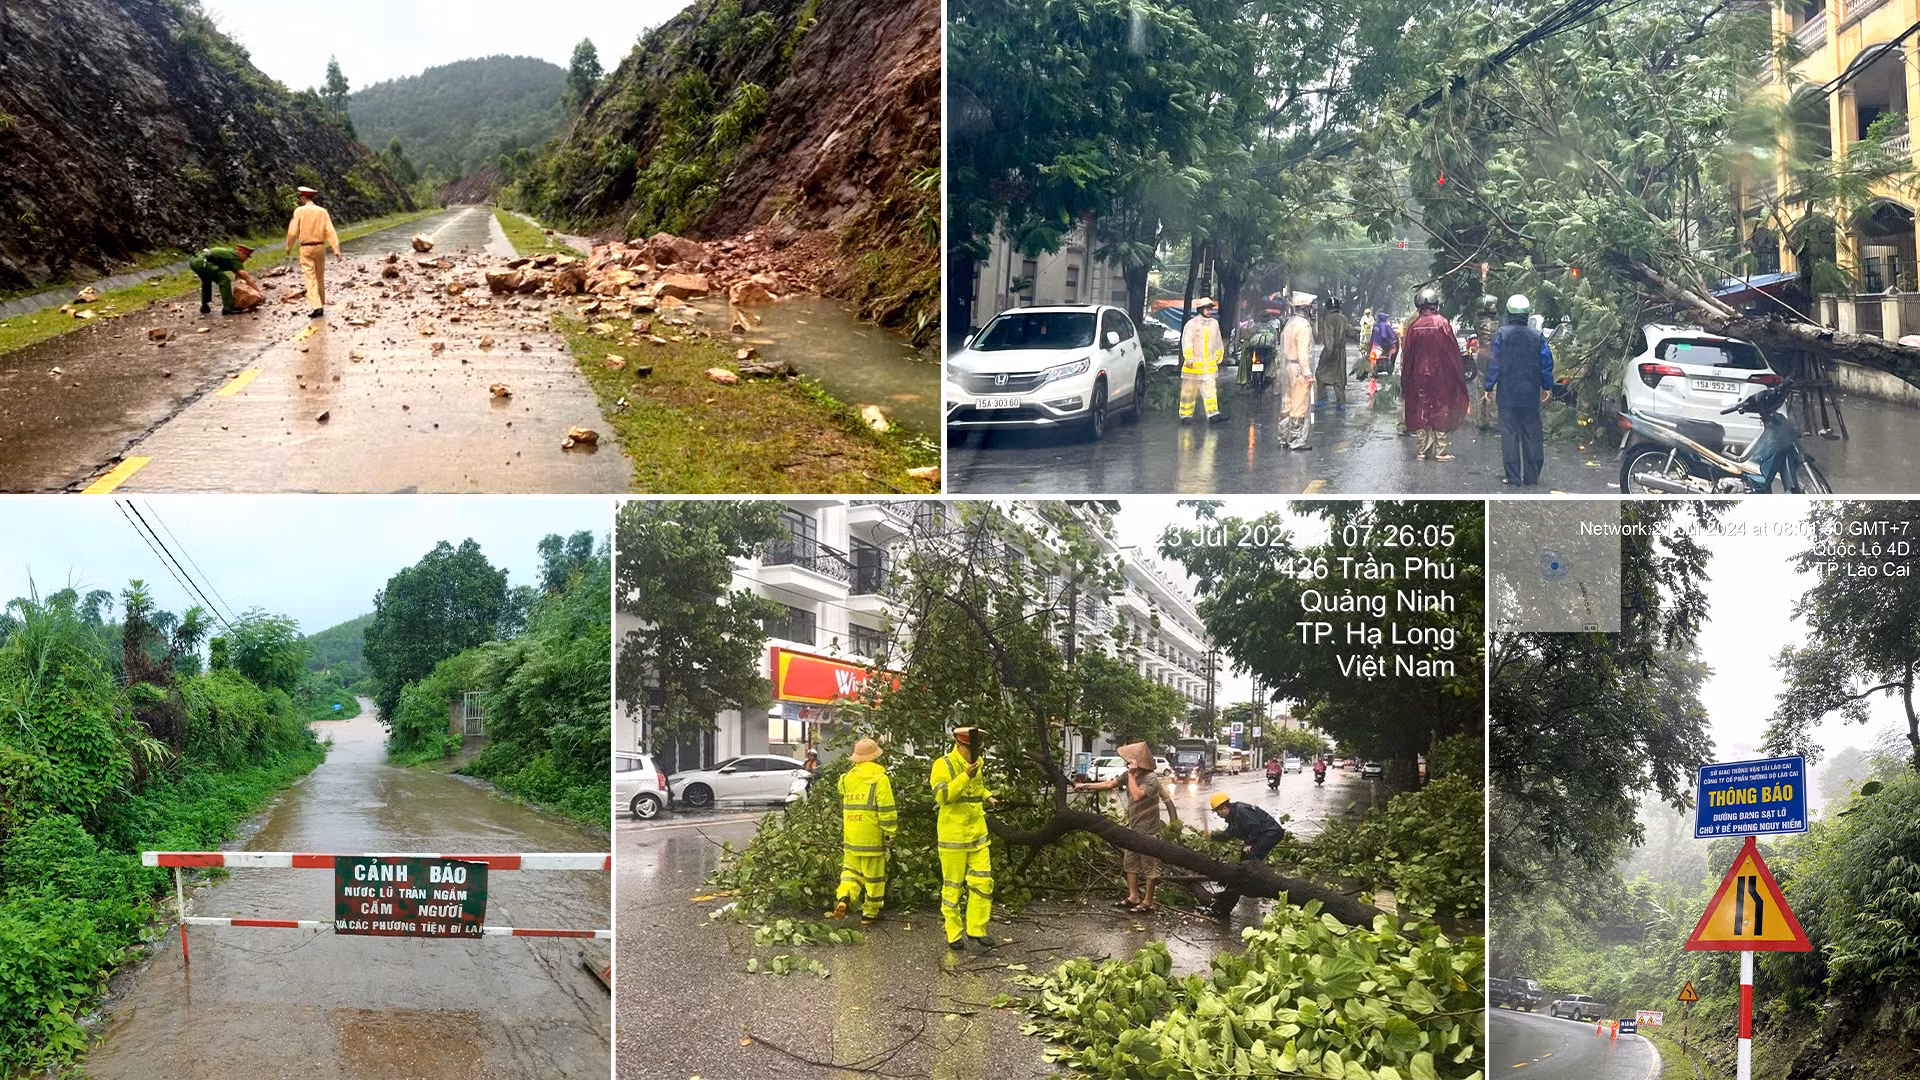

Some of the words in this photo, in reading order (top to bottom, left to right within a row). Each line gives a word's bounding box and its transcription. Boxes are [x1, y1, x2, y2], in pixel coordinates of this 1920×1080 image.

[1708, 786, 1757, 807] THÔNG
[1762, 782, 1793, 802] BÁO
[1713, 812, 1737, 822] ĐƯỜNG
[1739, 811, 1760, 820] ĐANG
[1762, 810, 1776, 819] SẠT
[1700, 825, 1714, 834] CHÚ
[1716, 824, 1720, 833] Ý
[1733, 822, 1758, 832] PHÒNG
[1760, 822, 1780, 830] NGUY
[354, 858, 408, 882] CẢNH
[430, 862, 467, 884] BÁO
[380, 886, 394, 898] LŨ
[399, 886, 427, 900] TRÀN
[360, 898, 392, 914] CẤM
[348, 918, 369, 930] CÁC
[372, 920, 416, 932] PHƯƠNG
